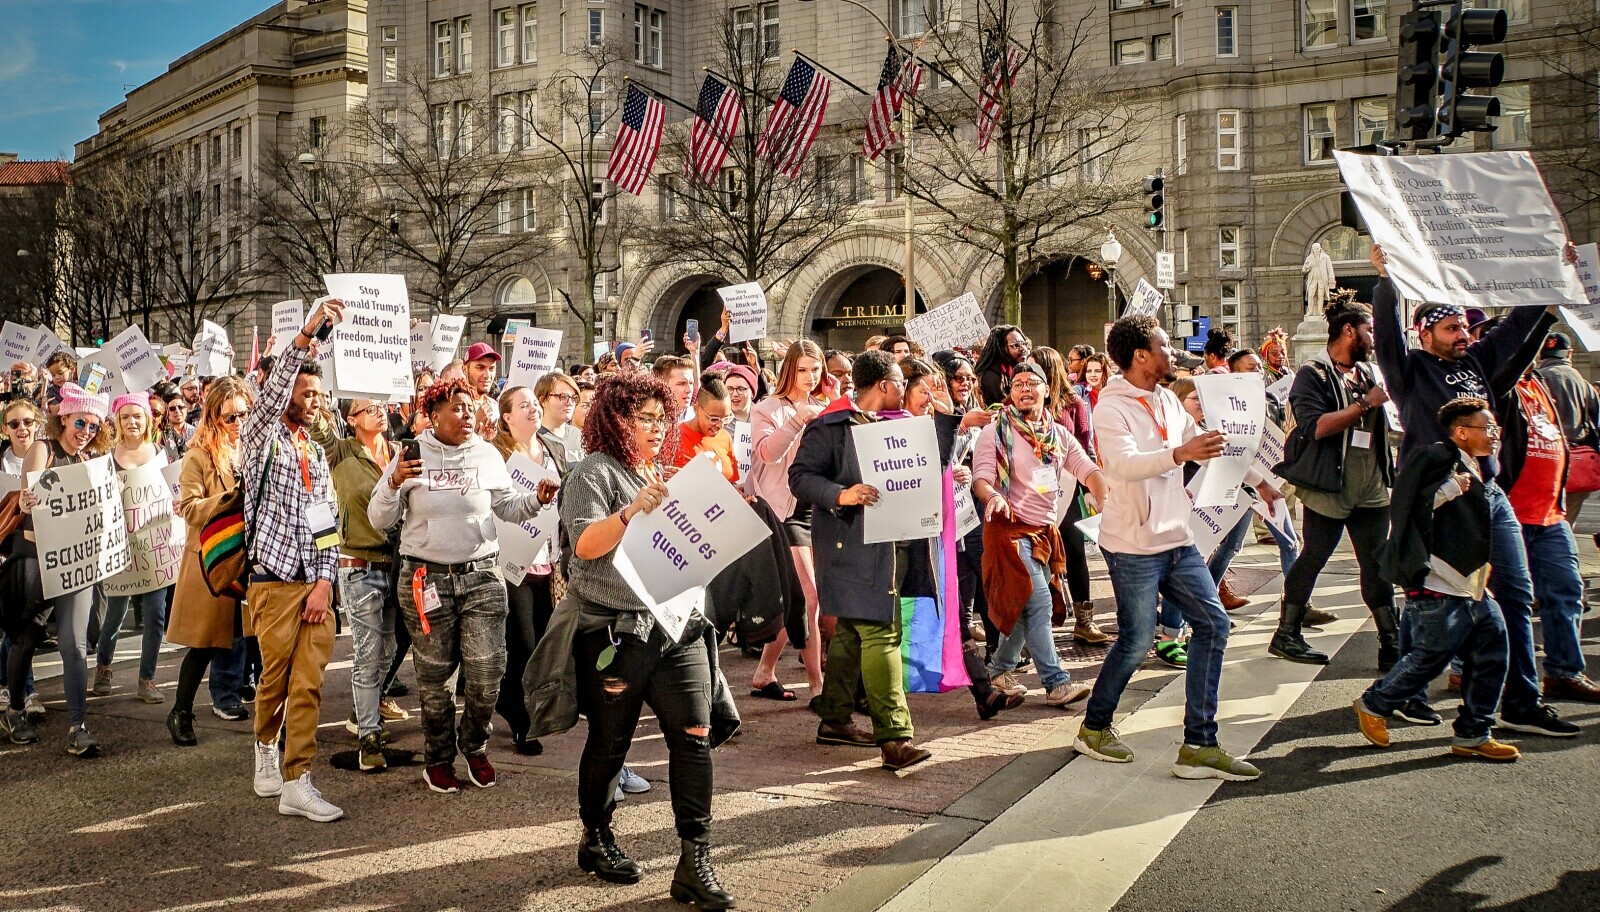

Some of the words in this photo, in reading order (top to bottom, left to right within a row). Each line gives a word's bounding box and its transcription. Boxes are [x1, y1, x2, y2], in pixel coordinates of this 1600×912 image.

[1407, 177, 1442, 188] Queer
[1400, 192, 1431, 205] fghan
[1432, 191, 1479, 203] Refugee
[1433, 205, 1468, 218] Illegal
[1470, 203, 1499, 214] Alien
[1468, 218, 1506, 230] Atheist
[1438, 235, 1505, 247] Marathoner
[1432, 250, 1465, 263] iggest
[1466, 248, 1506, 260] Badass
[1508, 247, 1559, 259] American
[359, 285, 380, 298] Stop
[344, 298, 370, 311] onald
[371, 300, 406, 315] Trump's
[352, 314, 379, 328] Attack
[381, 319, 393, 329] on
[836, 318, 890, 327] INTERNATIONAL
[907, 317, 921, 331] IF
[15, 331, 27, 341] The
[115, 334, 138, 353] smantle
[336, 329, 377, 345] Freedom,
[378, 333, 408, 346] Justice
[522, 336, 556, 348] Dismantle
[920, 328, 954, 348] EFUGEES
[4, 339, 24, 350] Future
[24, 344, 31, 352] is
[37, 343, 51, 357] White
[120, 346, 138, 360] White
[4, 349, 24, 360] Queer
[119, 350, 150, 372] Supremacy
[343, 347, 361, 359] and
[363, 348, 402, 365] Equality!
[528, 349, 548, 359] White
[516, 360, 552, 372] Supremacy
[106, 370, 114, 380] is
[1229, 396, 1247, 411] The
[1221, 419, 1249, 436] Future
[1249, 420, 1257, 436] is
[883, 435, 908, 450] The
[1222, 442, 1247, 457] Queer
[1261, 441, 1280, 463] White
[873, 457, 914, 473] Future
[915, 453, 928, 467] is
[433, 471, 476, 497] Obey
[885, 477, 922, 492] Queer
[953, 482, 967, 495] stice
[704, 502, 726, 523] El
[84, 511, 104, 535] MY
[662, 499, 702, 544] futuro
[698, 542, 717, 560] es
[148, 522, 172, 549] LAW
[44, 535, 103, 571] HANDS
[652, 530, 690, 571] queer
[60, 561, 103, 590] YOUR
